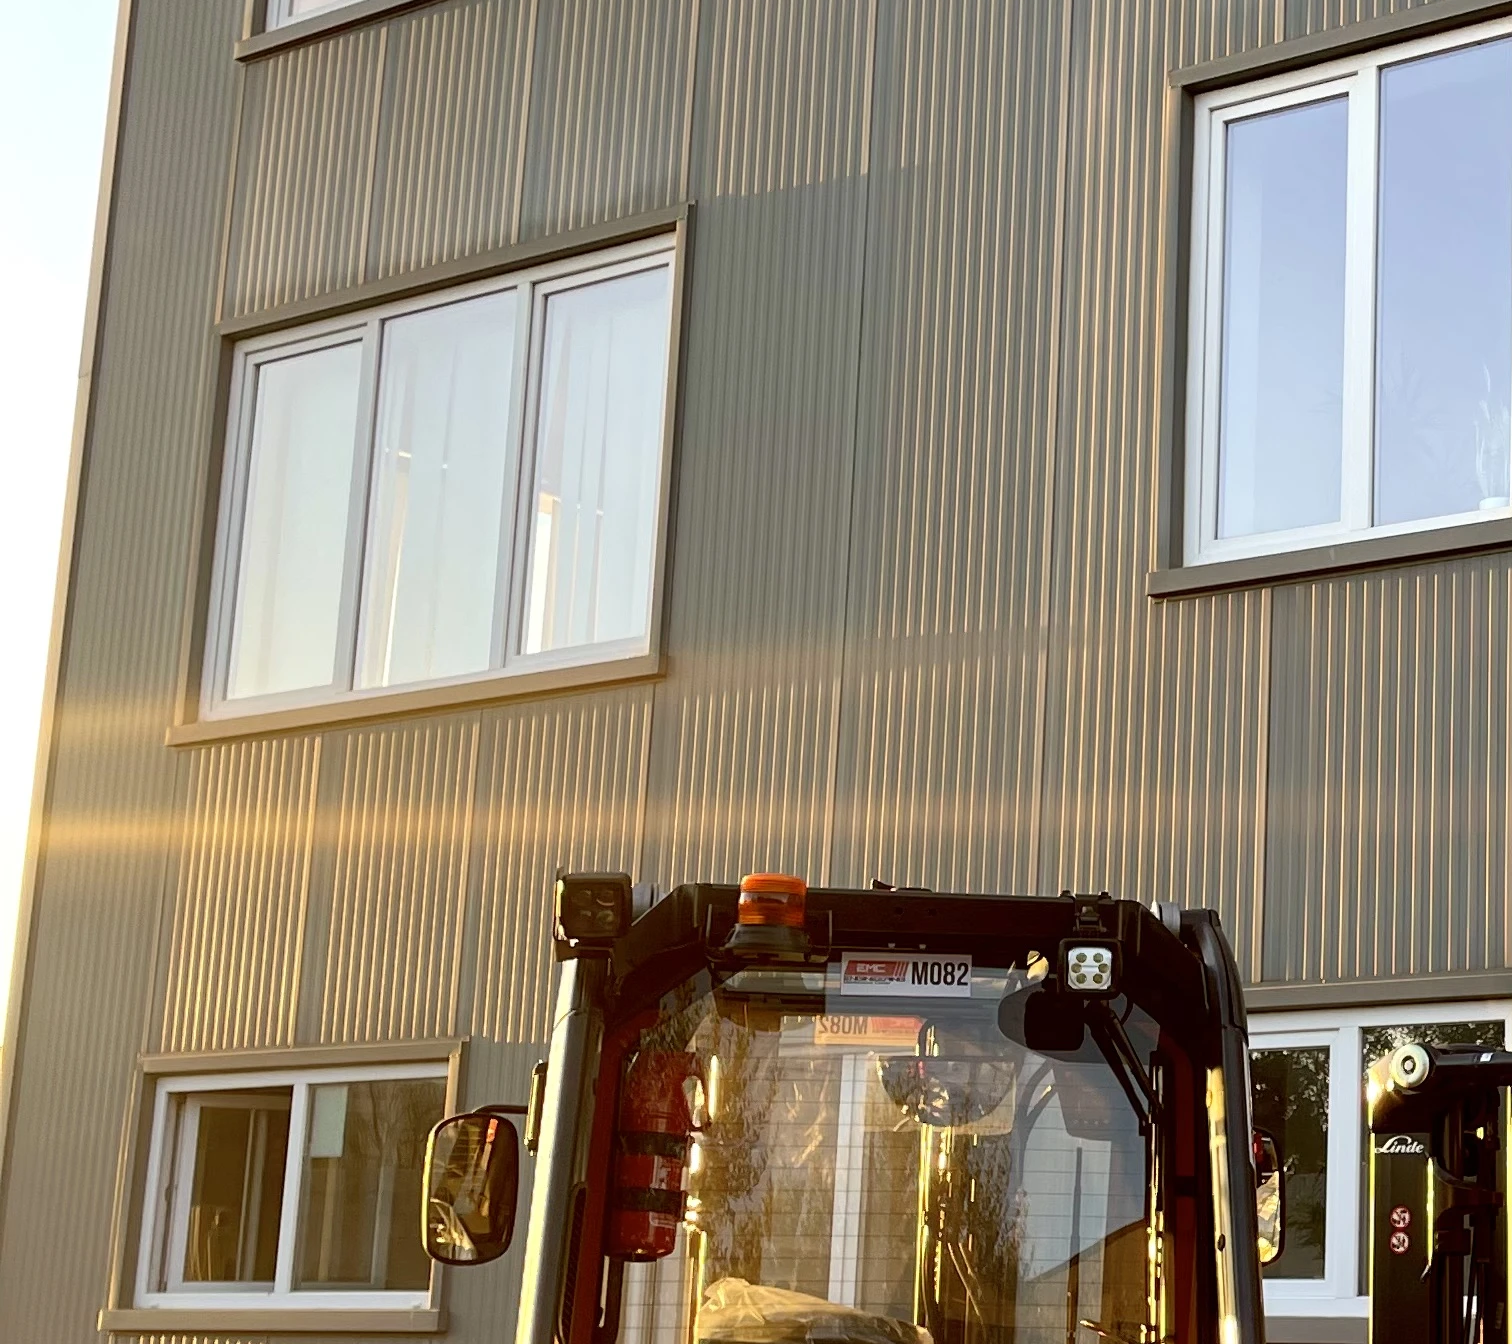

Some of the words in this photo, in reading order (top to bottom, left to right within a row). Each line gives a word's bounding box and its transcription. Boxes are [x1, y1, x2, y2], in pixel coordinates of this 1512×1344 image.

[856, 963, 886, 973] EMC
[911, 961, 969, 986] M082
[1375, 1135, 1424, 1154] Linde
